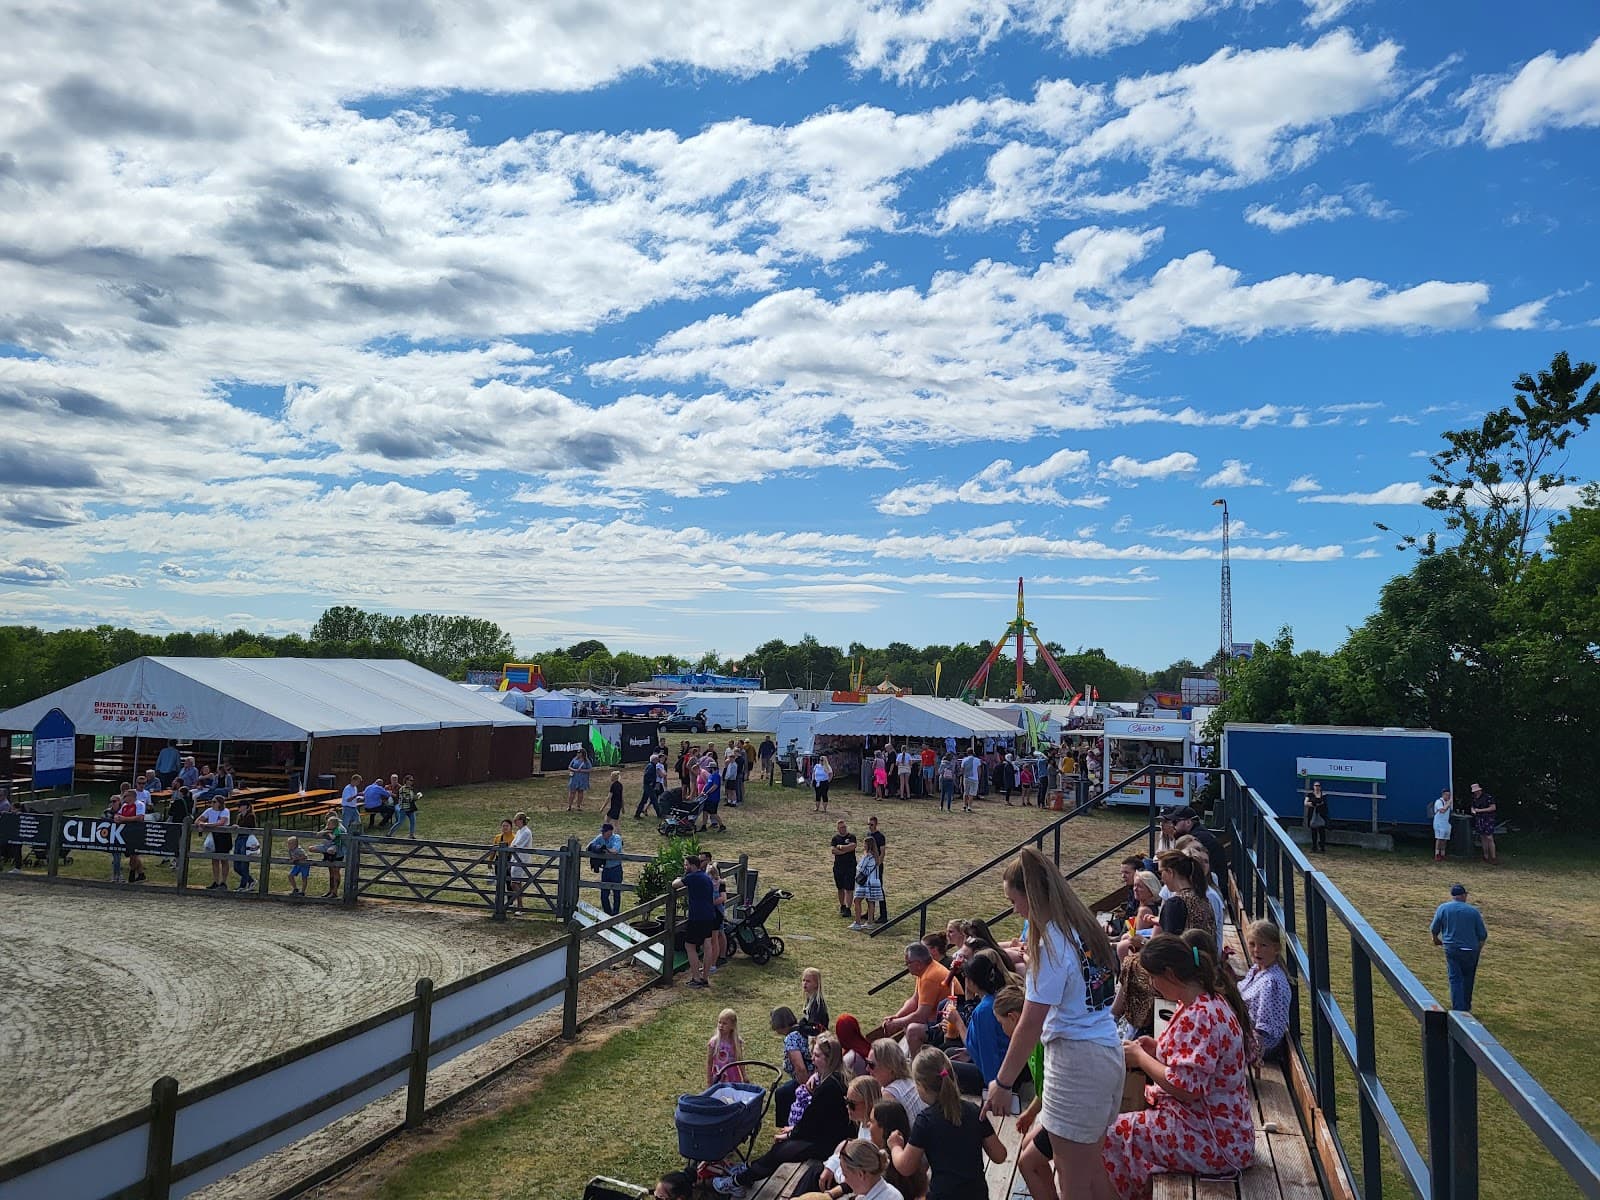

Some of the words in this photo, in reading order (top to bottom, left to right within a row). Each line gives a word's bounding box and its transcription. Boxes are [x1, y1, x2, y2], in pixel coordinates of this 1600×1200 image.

[1128, 722, 1166, 733] Churros
[1328, 764, 1353, 772] TOILET
[63, 819, 126, 845] CLICK
